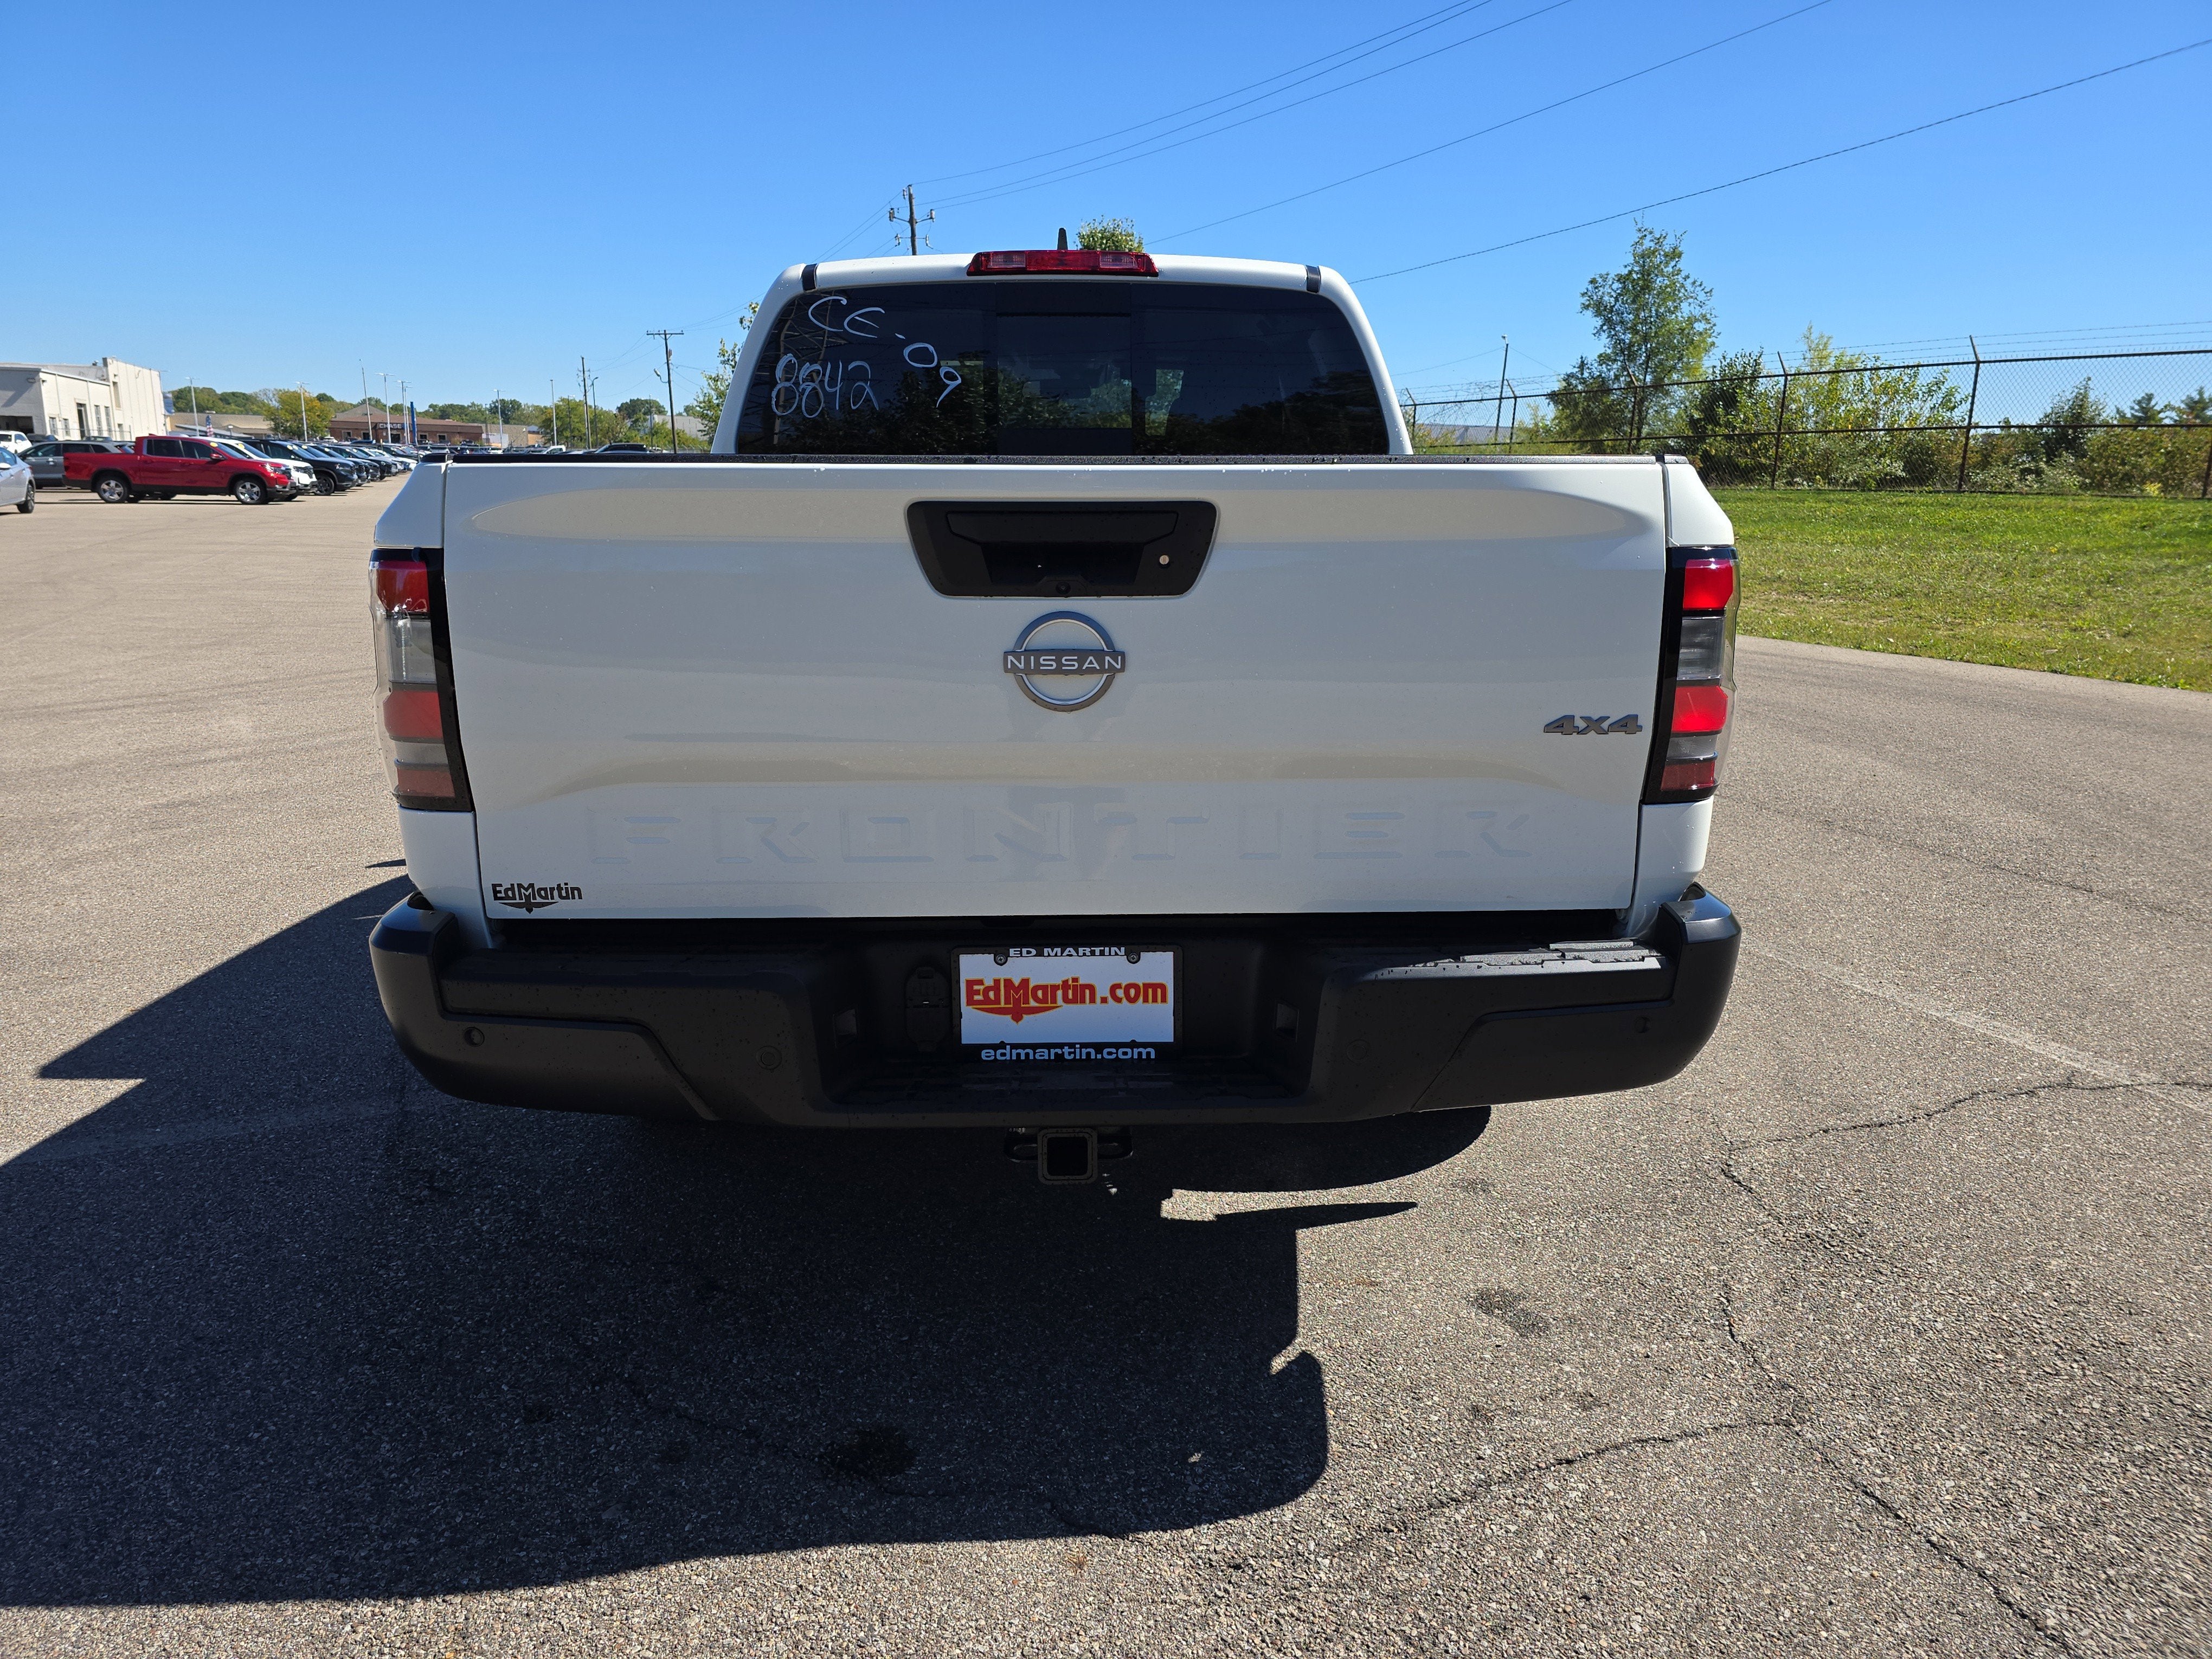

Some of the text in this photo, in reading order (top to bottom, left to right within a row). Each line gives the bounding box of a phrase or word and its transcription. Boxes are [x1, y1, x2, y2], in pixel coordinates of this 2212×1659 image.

[771, 353, 879, 417] 8842
[1007, 655, 1121, 670] NISSAN
[587, 805, 1533, 865] FRONTIER
[491, 882, 583, 901] EdMartin
[1009, 947, 1126, 957] ED MARTIN
[964, 976, 1168, 1007] EdMartin.com
[981, 1044, 1156, 1061] edmartin.com
